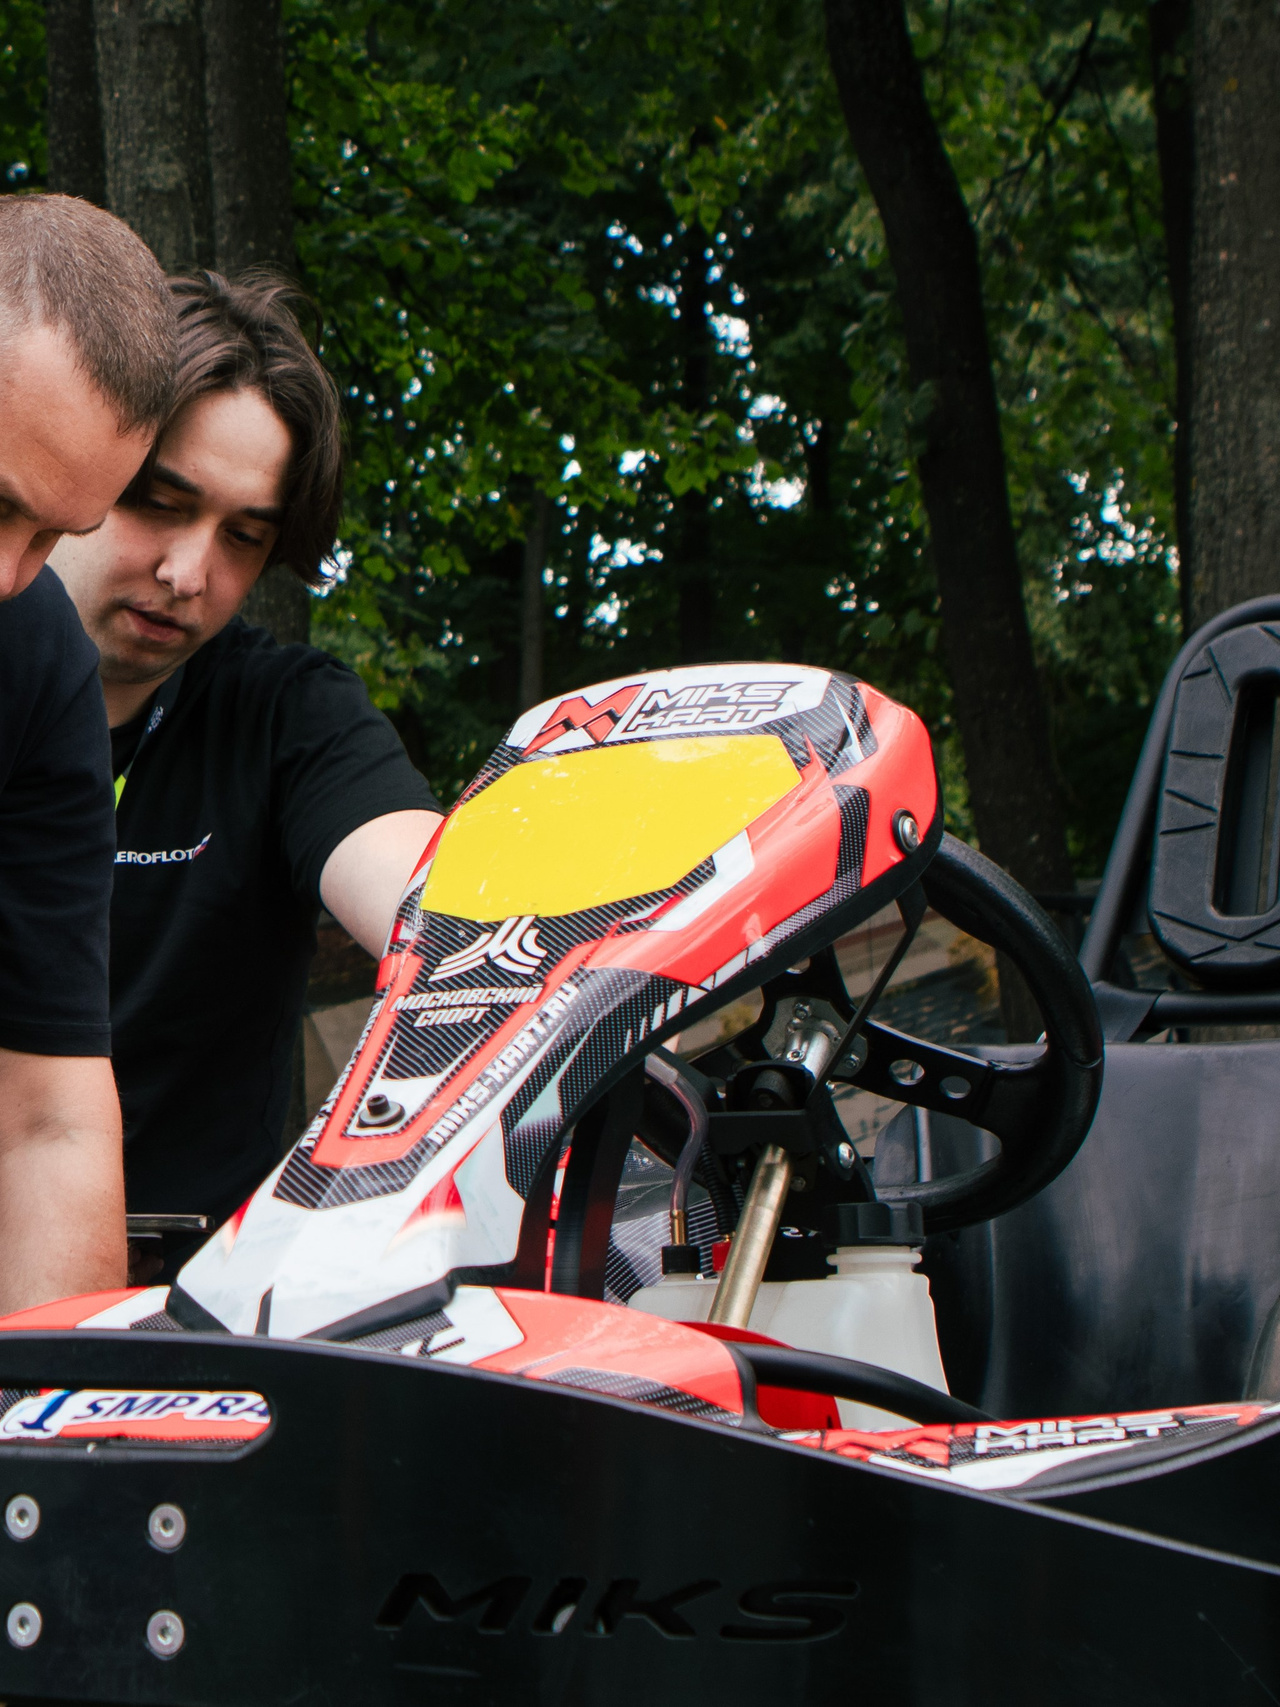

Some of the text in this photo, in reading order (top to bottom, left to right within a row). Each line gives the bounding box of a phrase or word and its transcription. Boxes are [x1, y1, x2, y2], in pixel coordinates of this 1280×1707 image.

[641, 683, 792, 711] MIKS
[627, 705, 776, 732] KART
[390, 983, 545, 1012] МОСКОВСКИЙ
[413, 1006, 491, 1028] СПОРТ
[71, 1396, 194, 1420] SMP
[375, 1574, 860, 1643] MIKS
